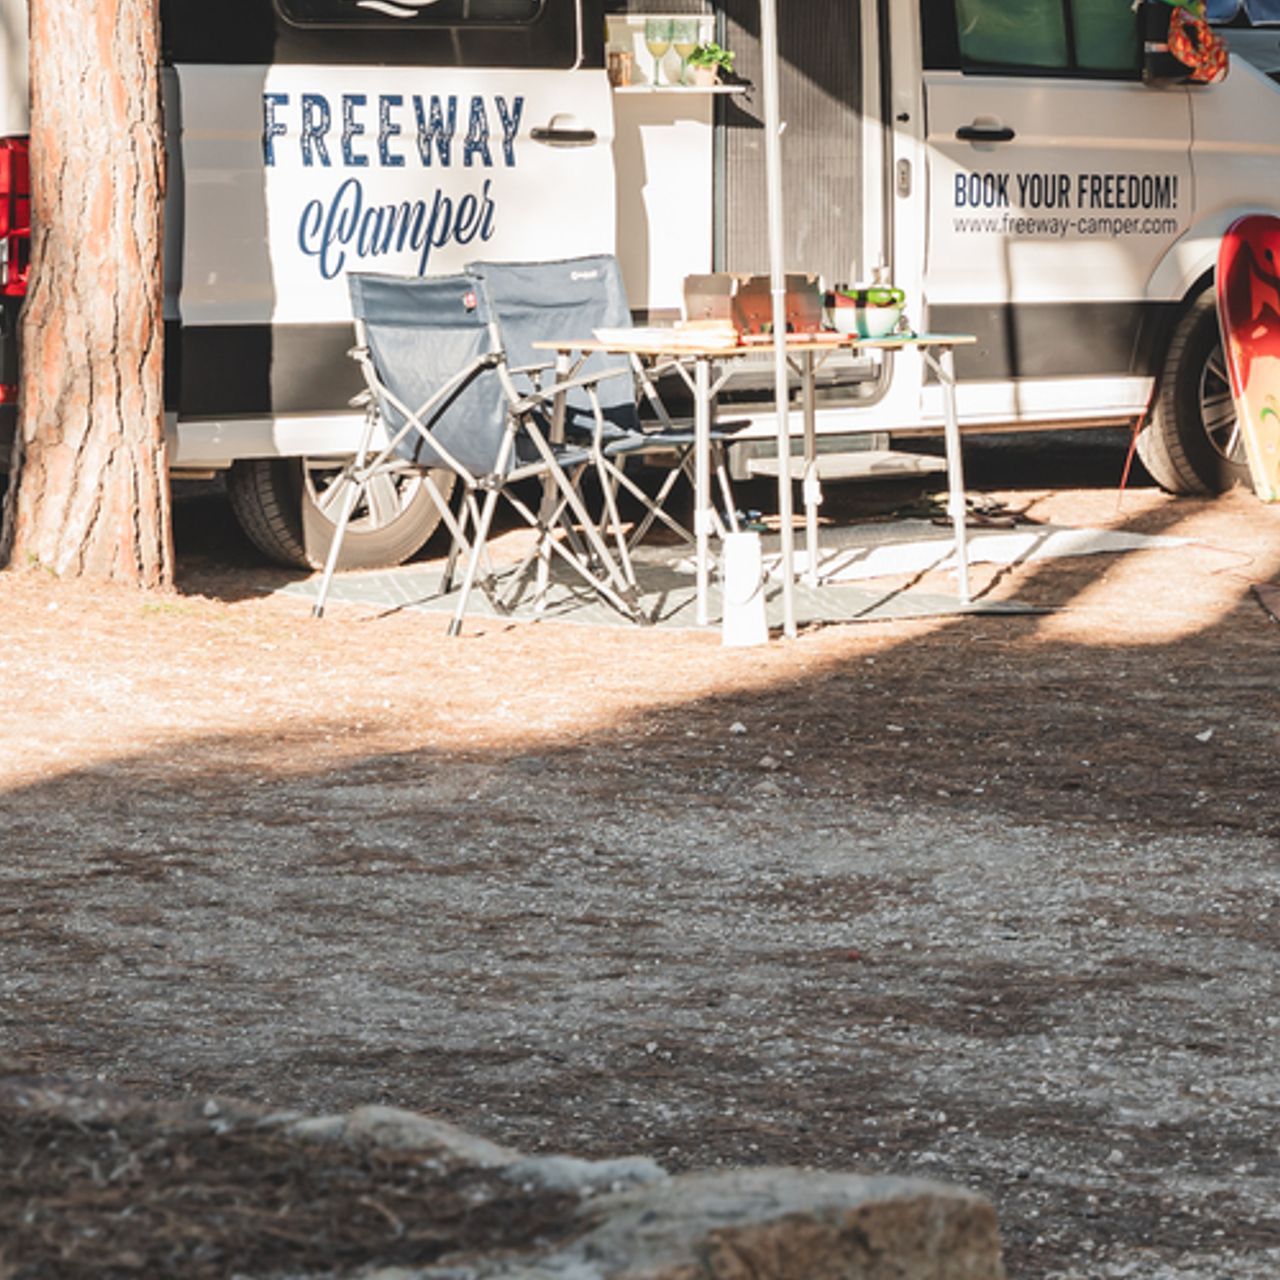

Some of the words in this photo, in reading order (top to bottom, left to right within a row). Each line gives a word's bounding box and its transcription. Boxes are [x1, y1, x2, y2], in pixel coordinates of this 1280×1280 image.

[263, 93, 524, 167] FREEWAY
[954, 173, 1010, 209] BOOK
[1016, 173, 1070, 209] YOUR
[1077, 174, 1179, 209] FREEDOM!
[298, 177, 495, 279] Camper
[952, 212, 1178, 238] www.freeway-camper.com
